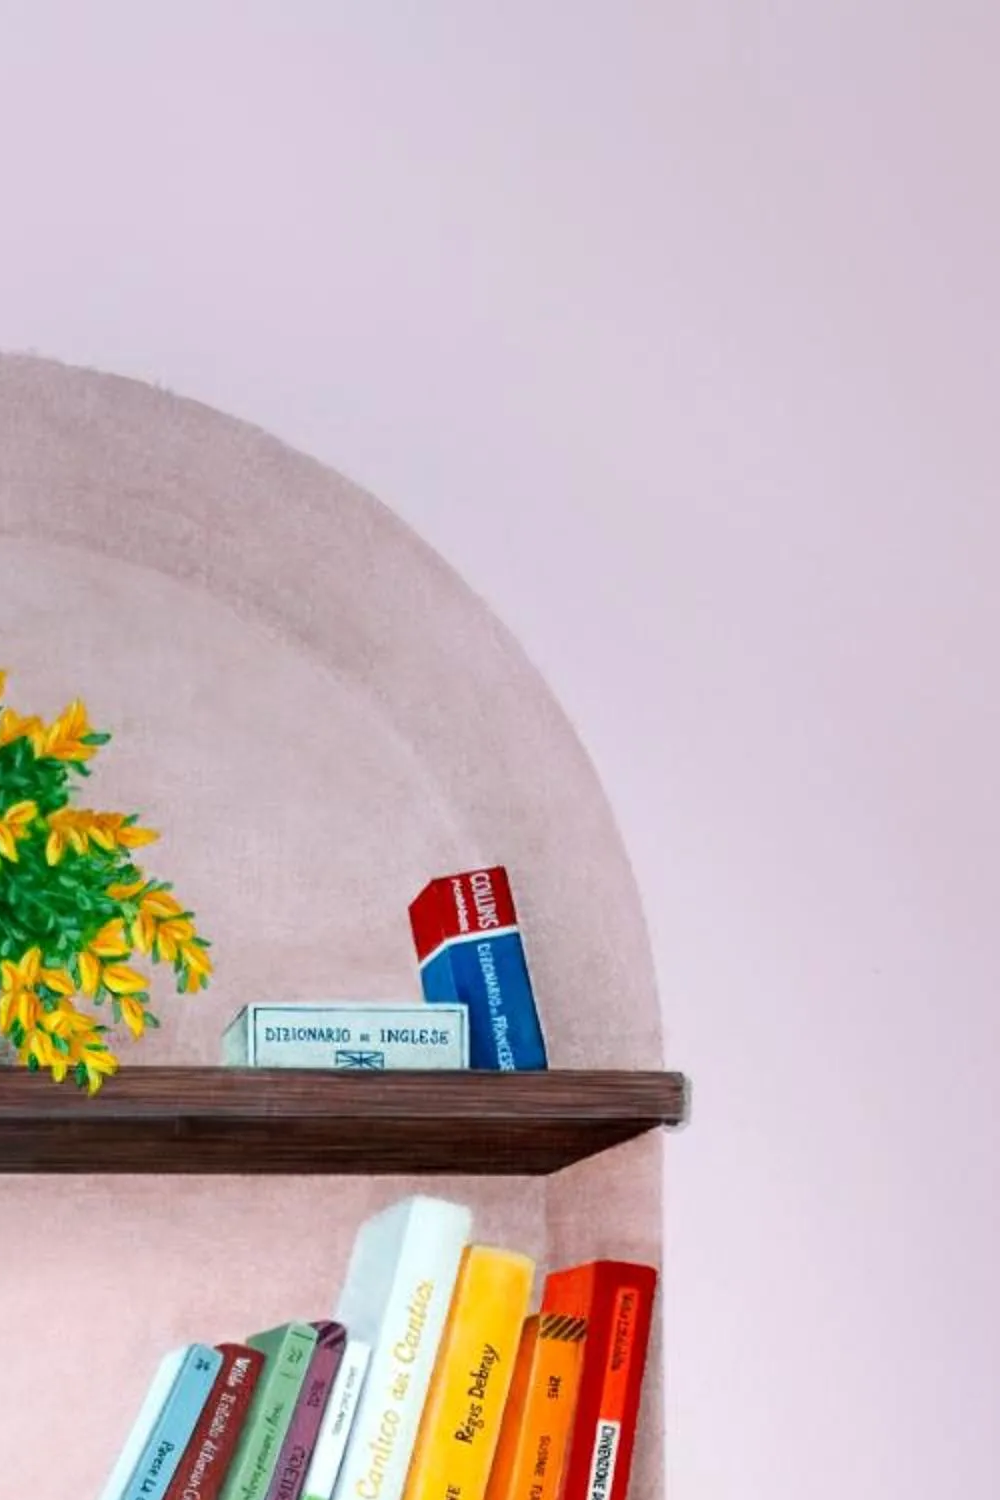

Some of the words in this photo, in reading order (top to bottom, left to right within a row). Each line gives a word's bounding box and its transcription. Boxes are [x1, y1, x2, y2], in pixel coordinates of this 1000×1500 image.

[468, 871, 499, 929] COLLINS
[264, 1026, 351, 1043] DIZIONARIO
[379, 1028, 450, 1045] INGLESE
[466, 1343, 500, 1400] Debray
